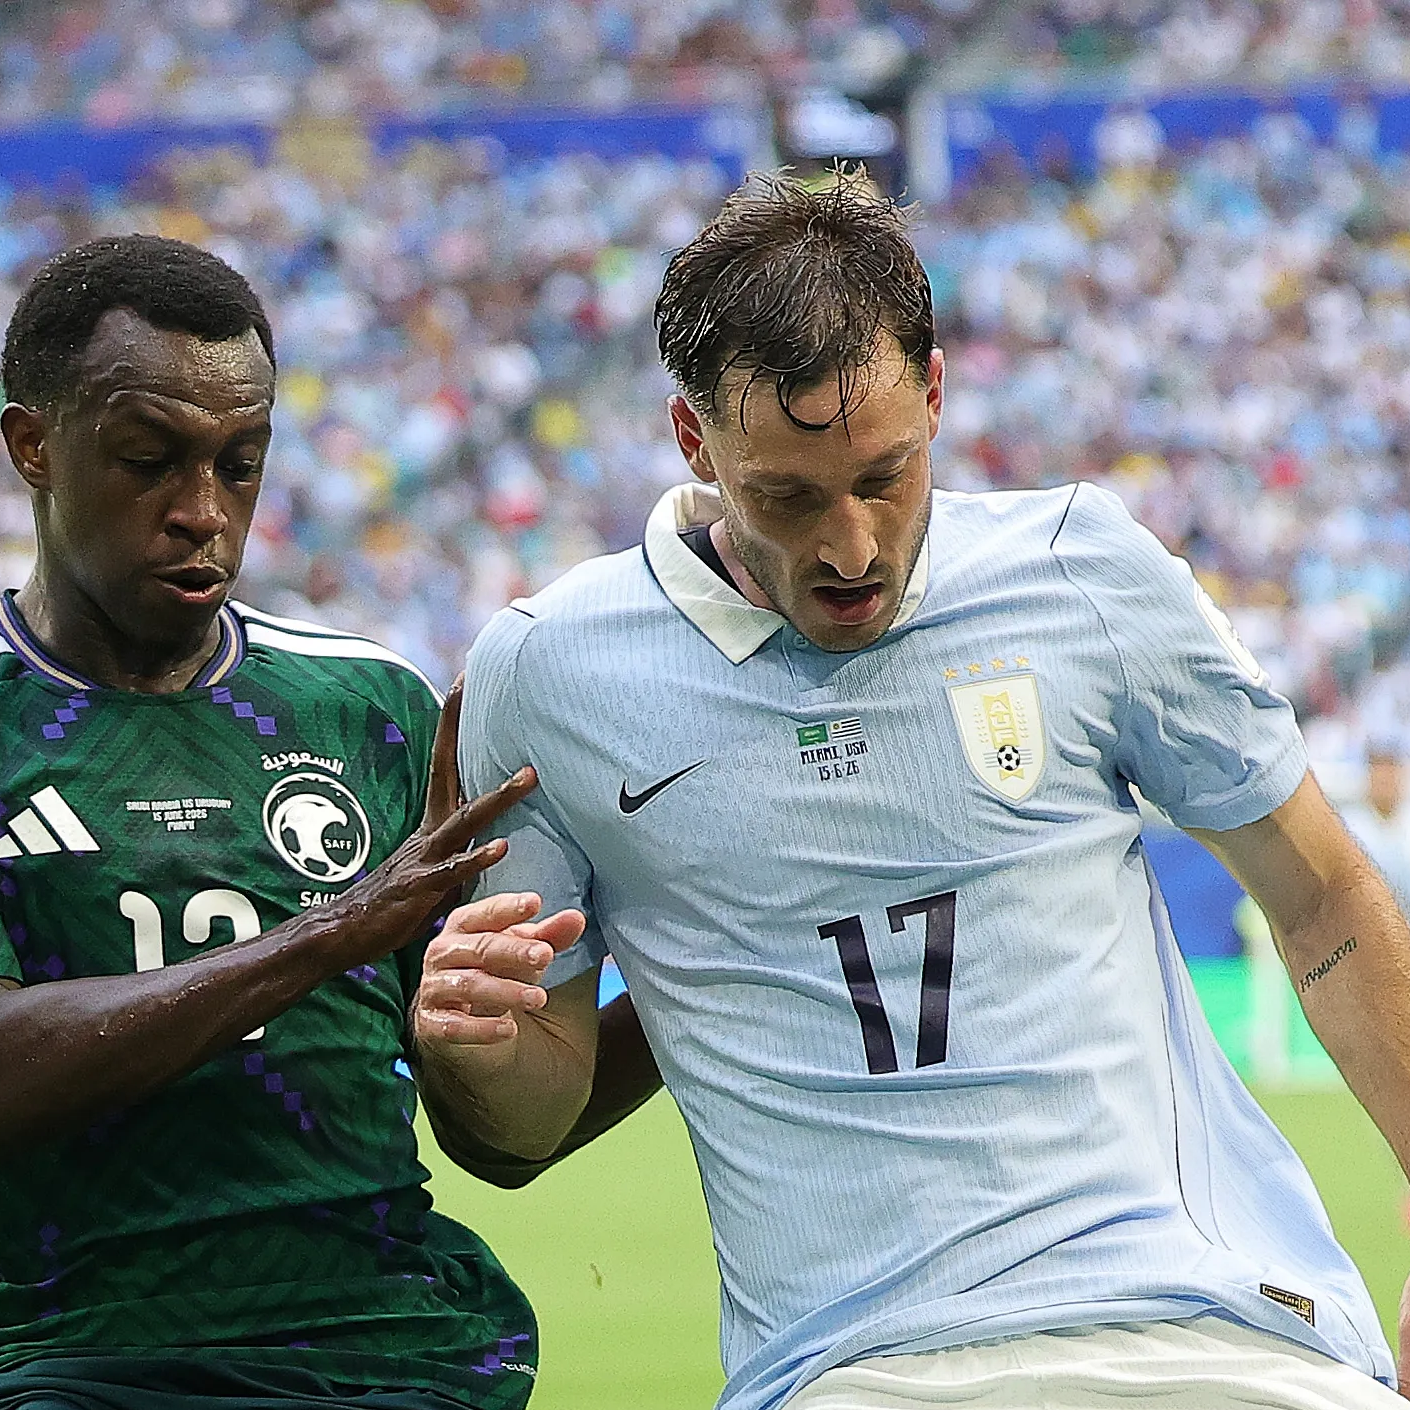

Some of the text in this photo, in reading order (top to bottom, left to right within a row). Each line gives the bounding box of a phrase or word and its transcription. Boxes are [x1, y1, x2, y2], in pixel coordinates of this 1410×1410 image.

[845, 741, 868, 757] USA
[261, 752, 344, 776] السعودية
[324, 838, 353, 850] SAFF
[300, 891, 343, 908] SAU
[817, 890, 957, 1075] 17
